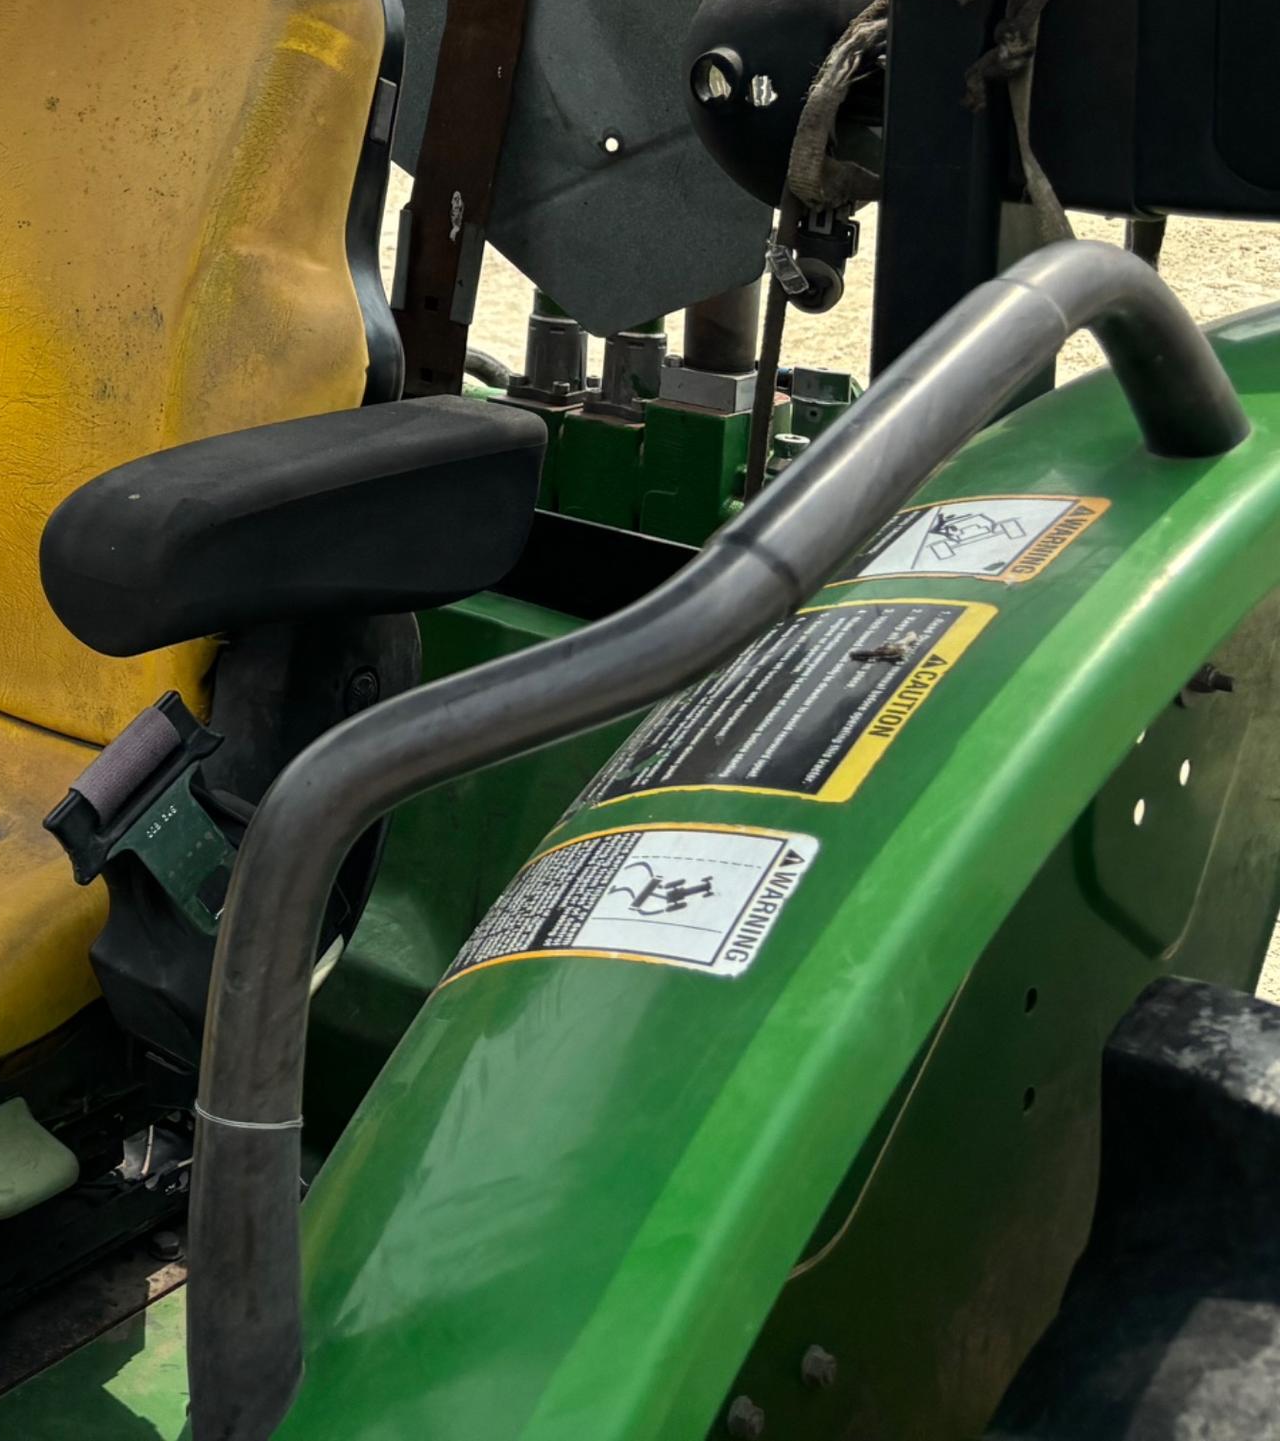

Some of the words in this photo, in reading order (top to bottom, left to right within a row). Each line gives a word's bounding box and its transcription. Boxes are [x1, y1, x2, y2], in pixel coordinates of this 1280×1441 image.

[1011, 513, 1089, 574] WARNING
[869, 669, 941, 738] CAUTION
[725, 872, 797, 963] WARNING
